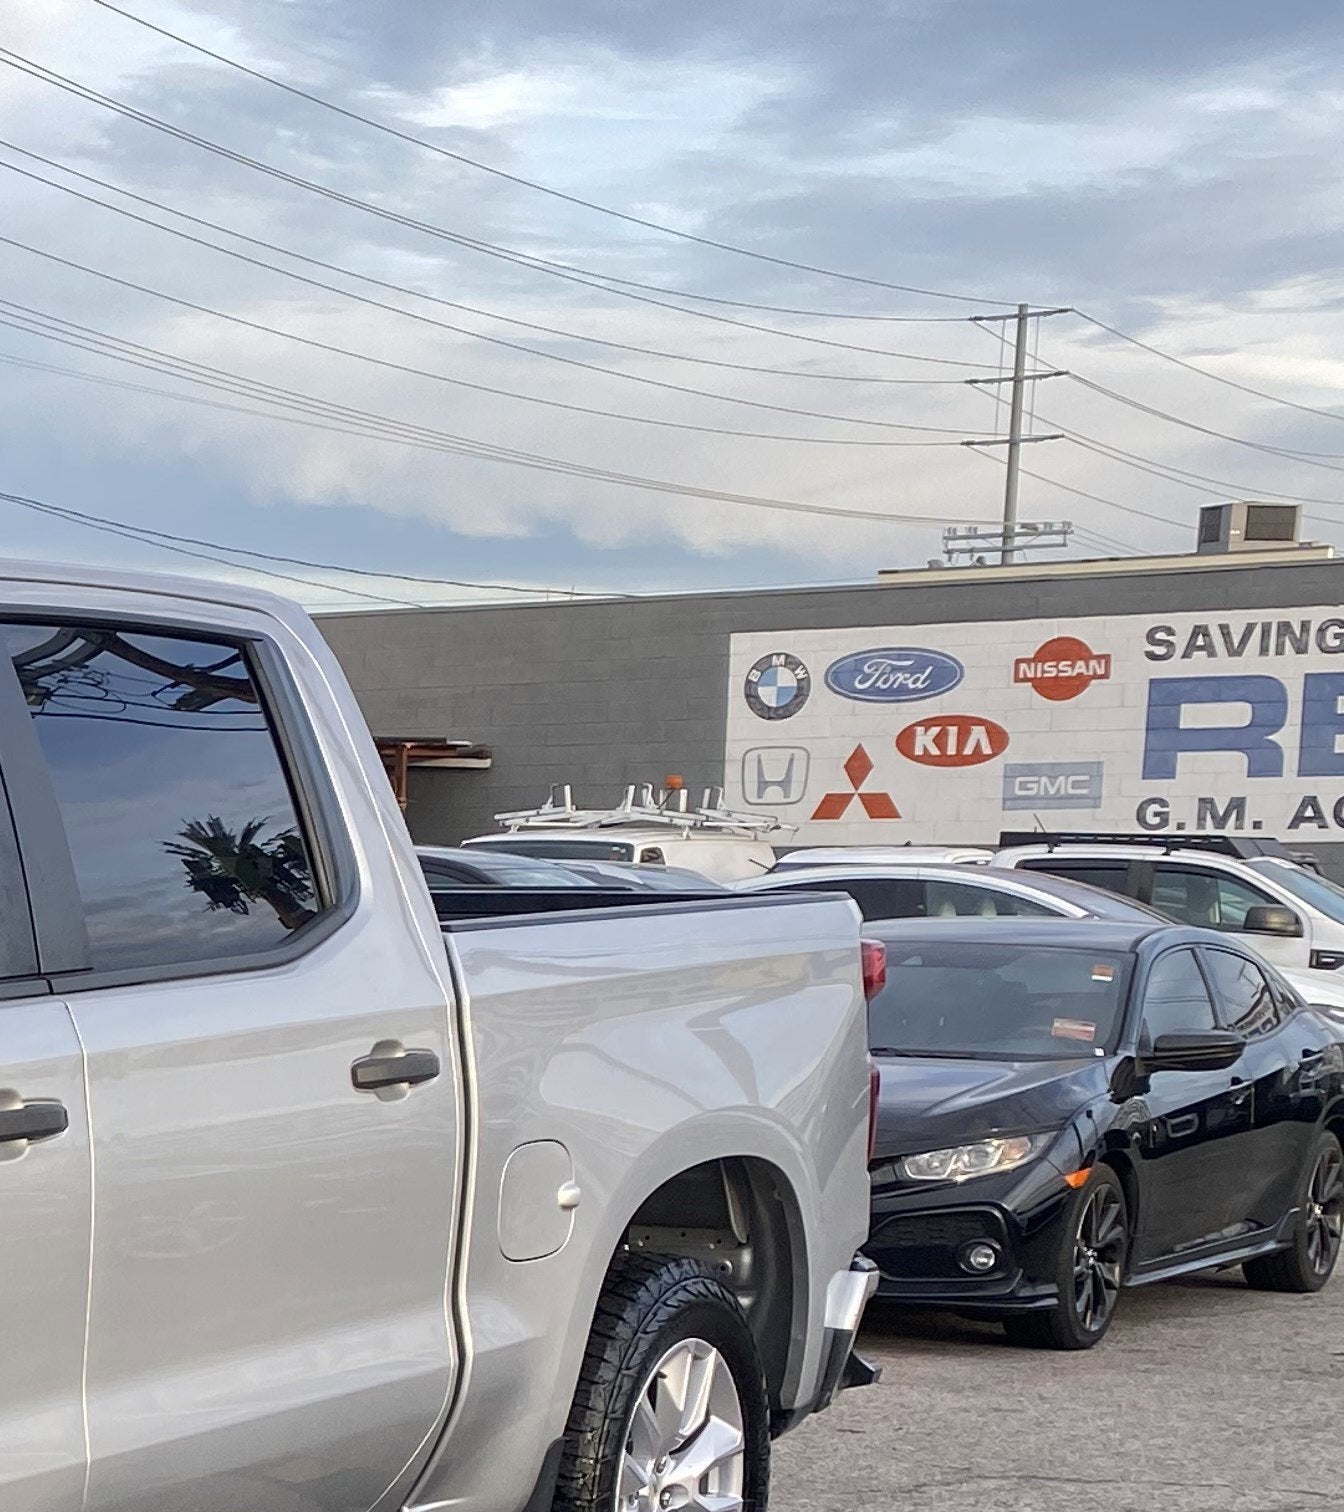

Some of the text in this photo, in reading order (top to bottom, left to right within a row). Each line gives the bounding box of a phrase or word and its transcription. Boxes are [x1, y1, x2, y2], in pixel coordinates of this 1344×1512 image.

[1144, 618, 1344, 661] SAVING
[748, 654, 808, 682] BMW
[854, 658, 934, 690] Ford
[1018, 659, 1106, 679] NISSAN
[913, 725, 993, 756] KIA
[1014, 775, 1090, 796] GMC
[1136, 797, 1262, 831] G.M.
